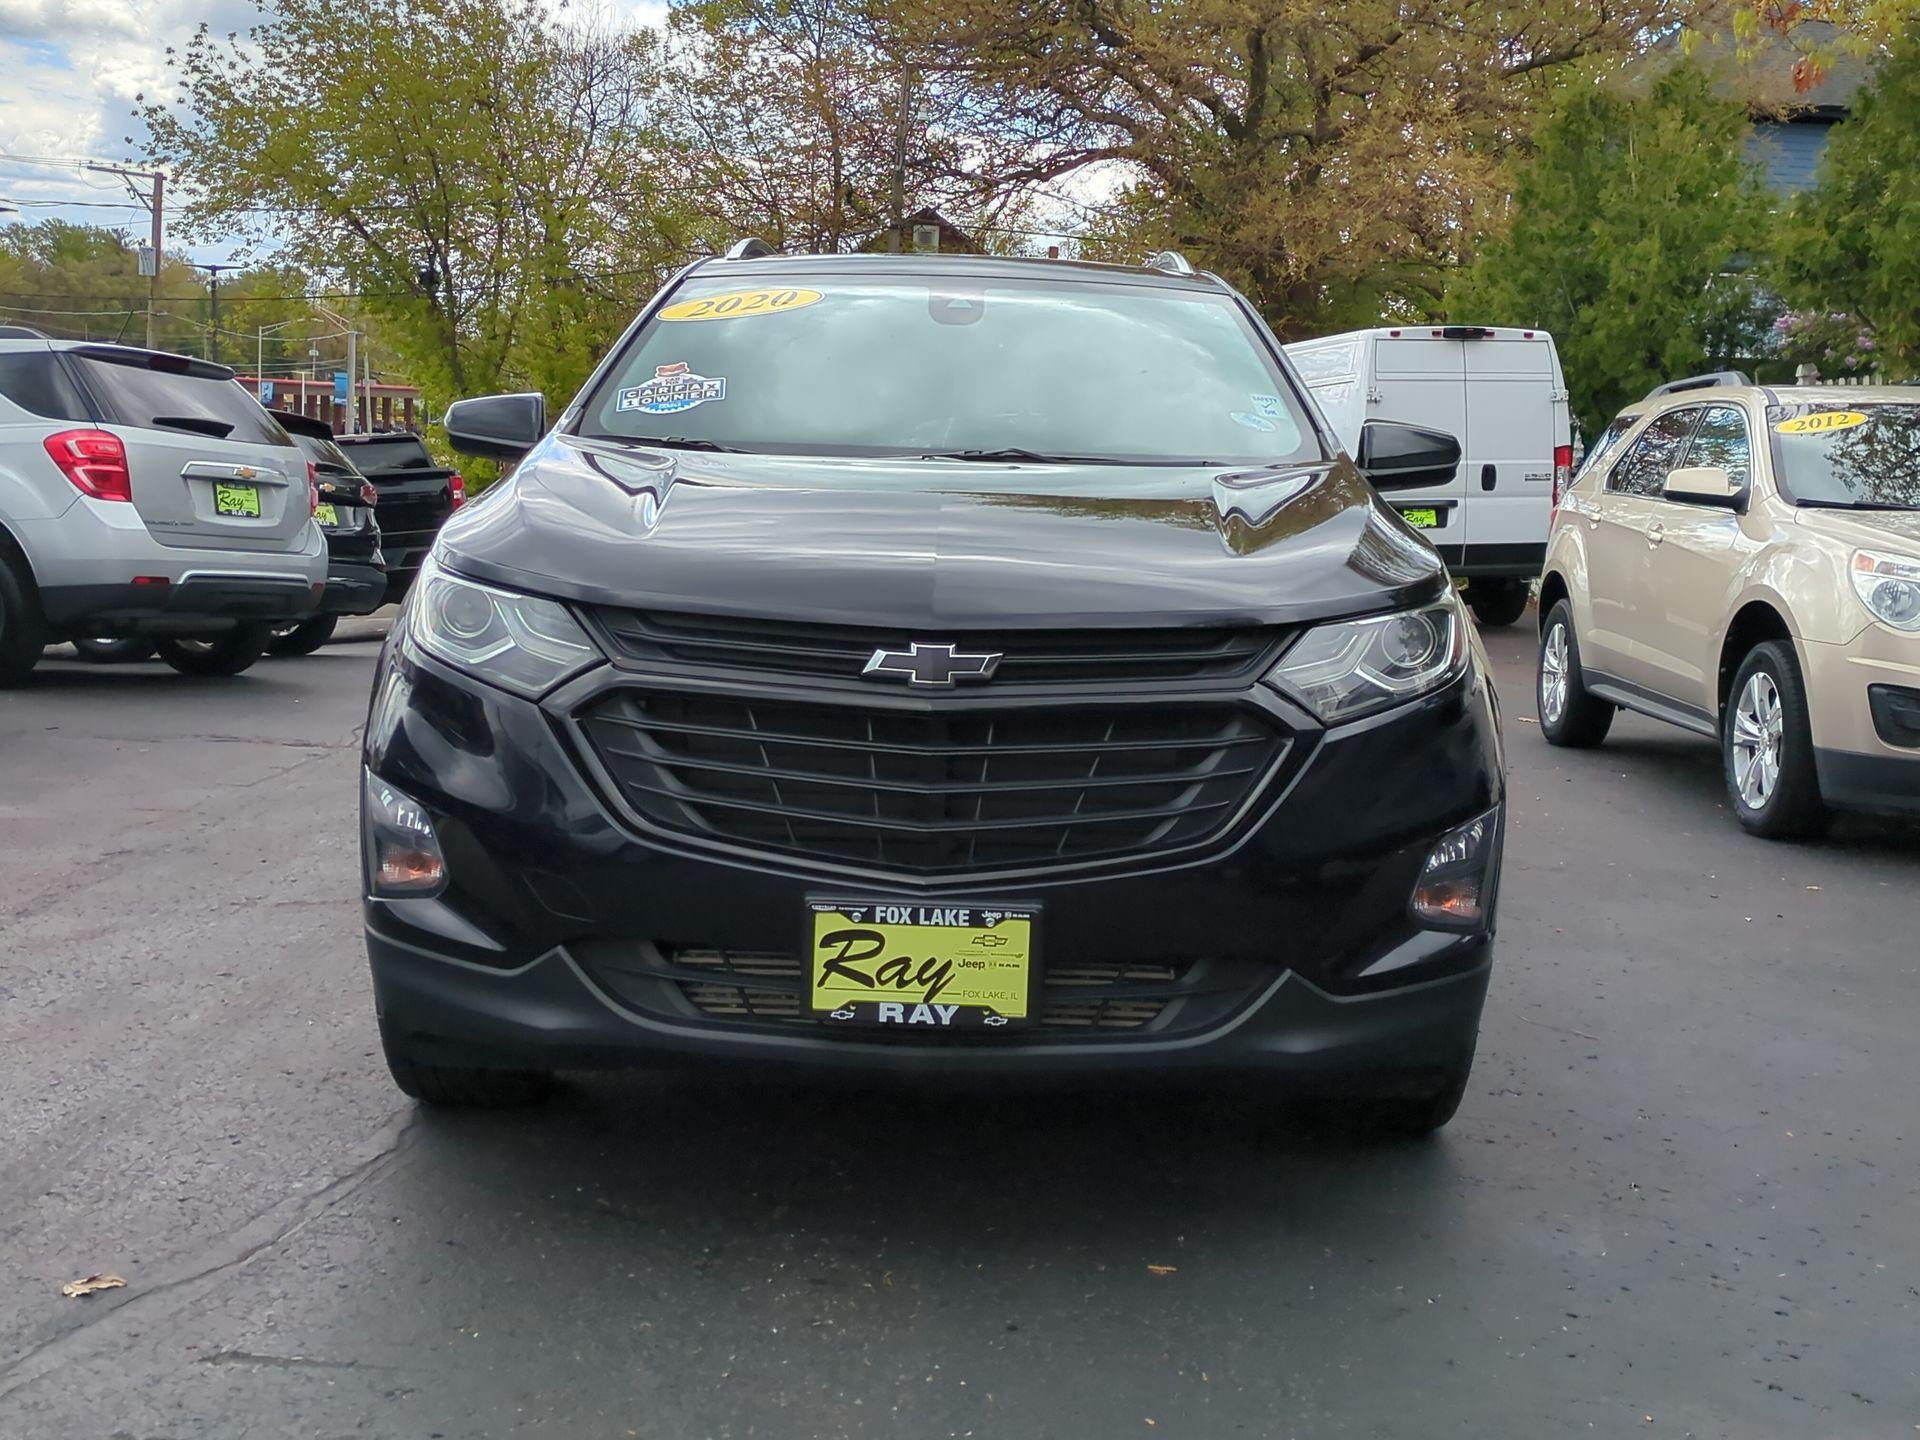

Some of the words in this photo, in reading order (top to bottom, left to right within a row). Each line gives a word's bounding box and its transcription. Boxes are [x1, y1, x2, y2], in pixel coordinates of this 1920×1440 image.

[687, 291, 798, 318] 2020
[626, 382, 717, 398] CARFAX
[1794, 414, 1850, 431] 2012
[218, 490, 244, 510] Ray
[875, 906, 913, 925] FOX
[918, 907, 970, 927] LAKE
[816, 928, 956, 1004] Ray
[957, 958, 986, 970] Jeep
[962, 989, 980, 999] FOX
[1010, 992, 1018, 1000] IL
[878, 1002, 960, 1025] RAY
